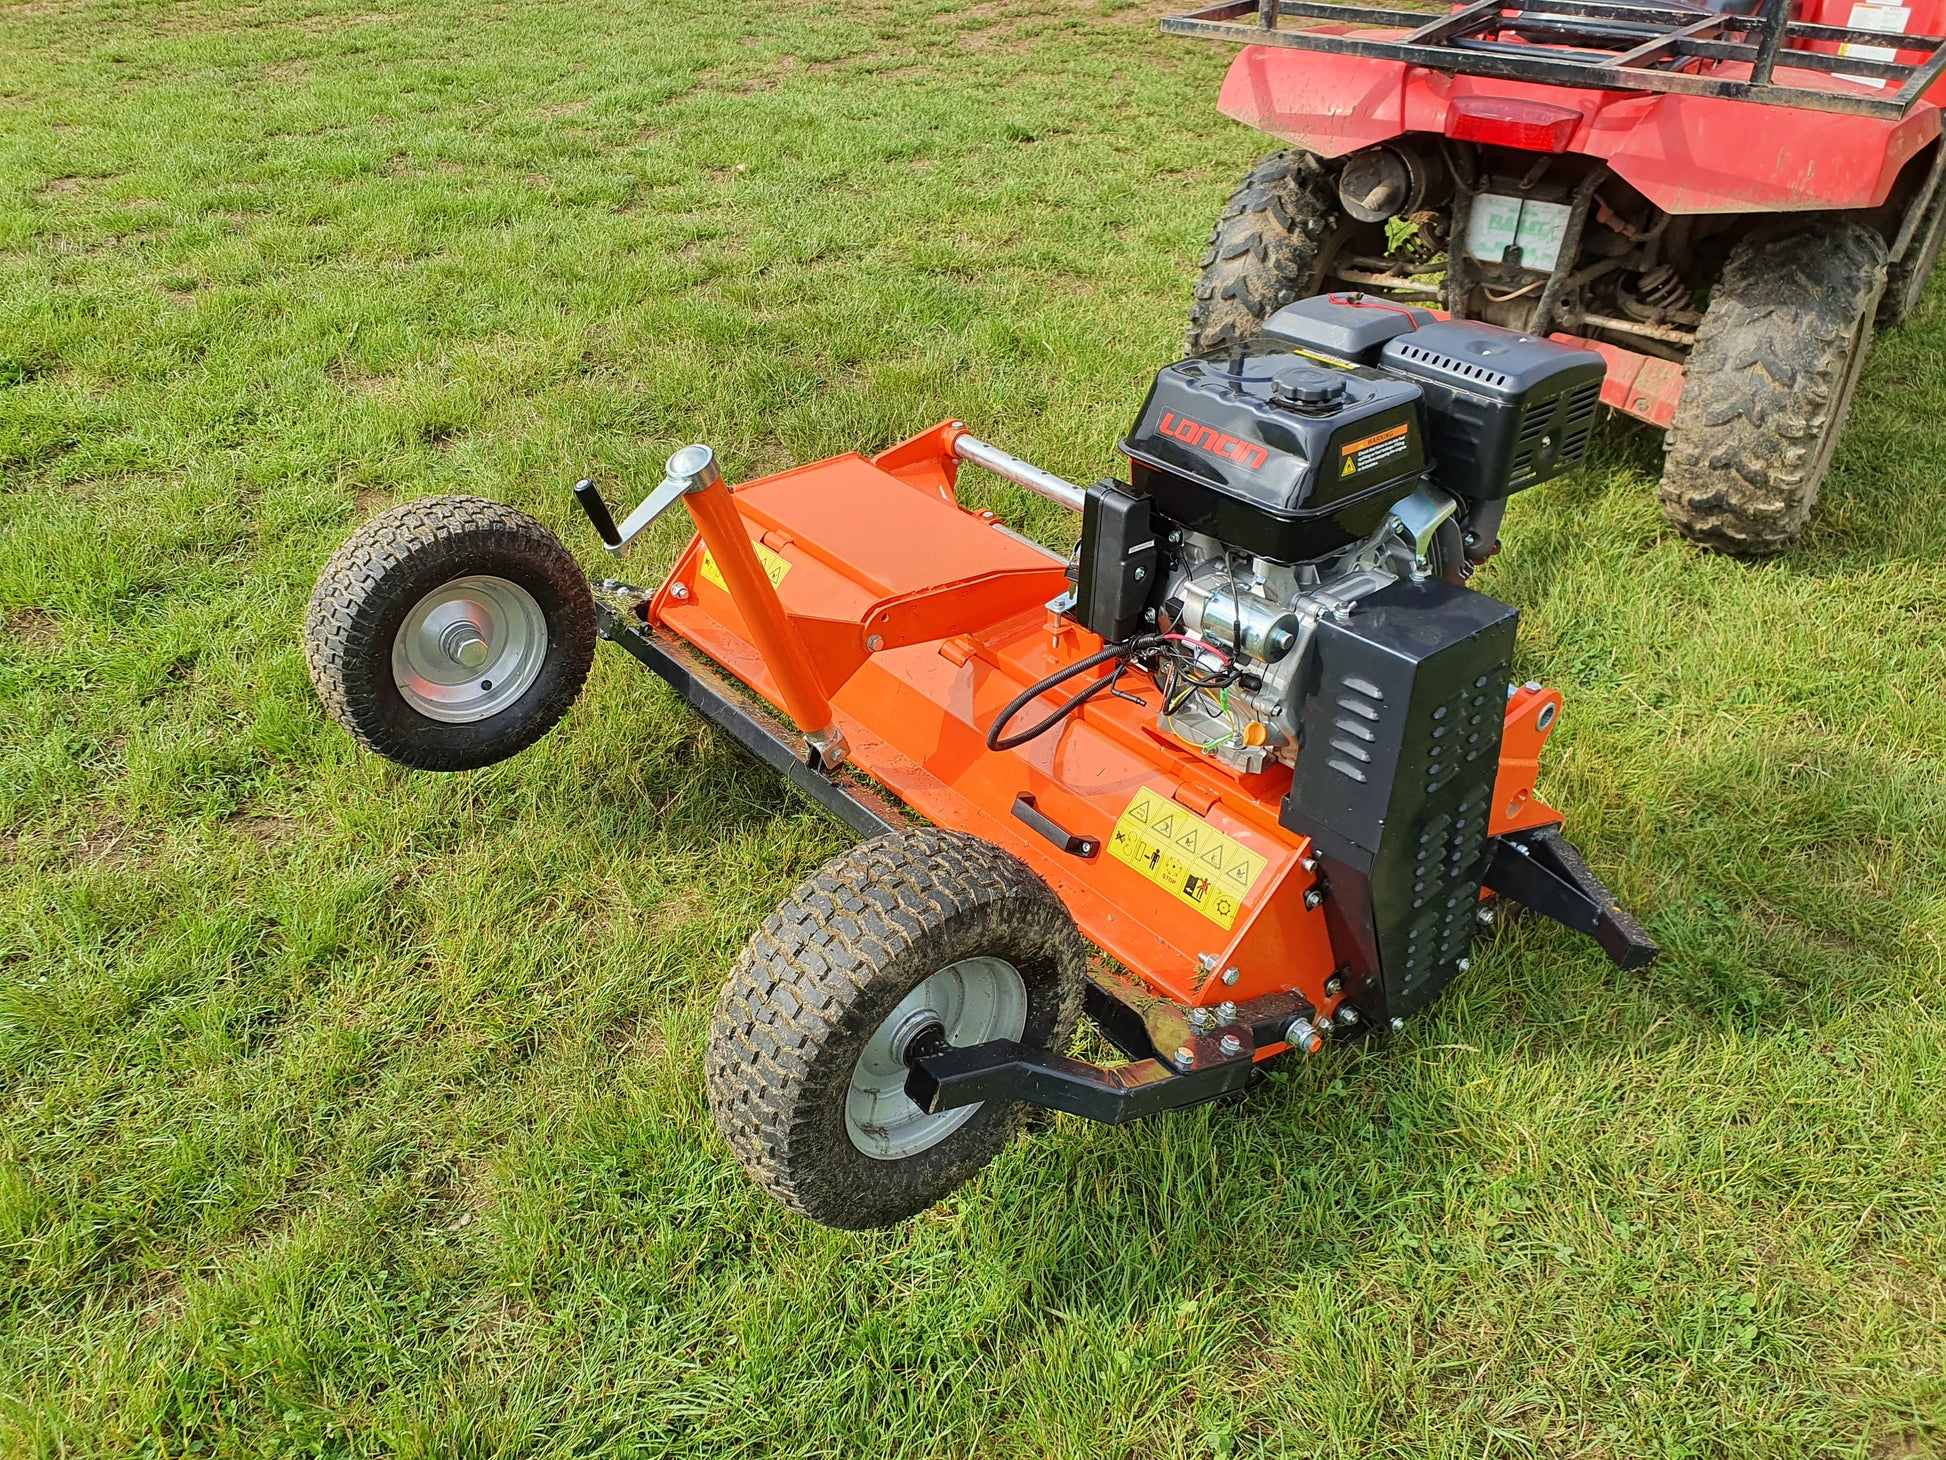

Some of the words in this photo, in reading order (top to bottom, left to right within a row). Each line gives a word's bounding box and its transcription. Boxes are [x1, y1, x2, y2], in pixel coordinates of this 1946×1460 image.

[1159, 412, 1269, 470] LONCIN
[1367, 431, 1394, 445] WARNING
[1161, 873, 1177, 885] STOP
